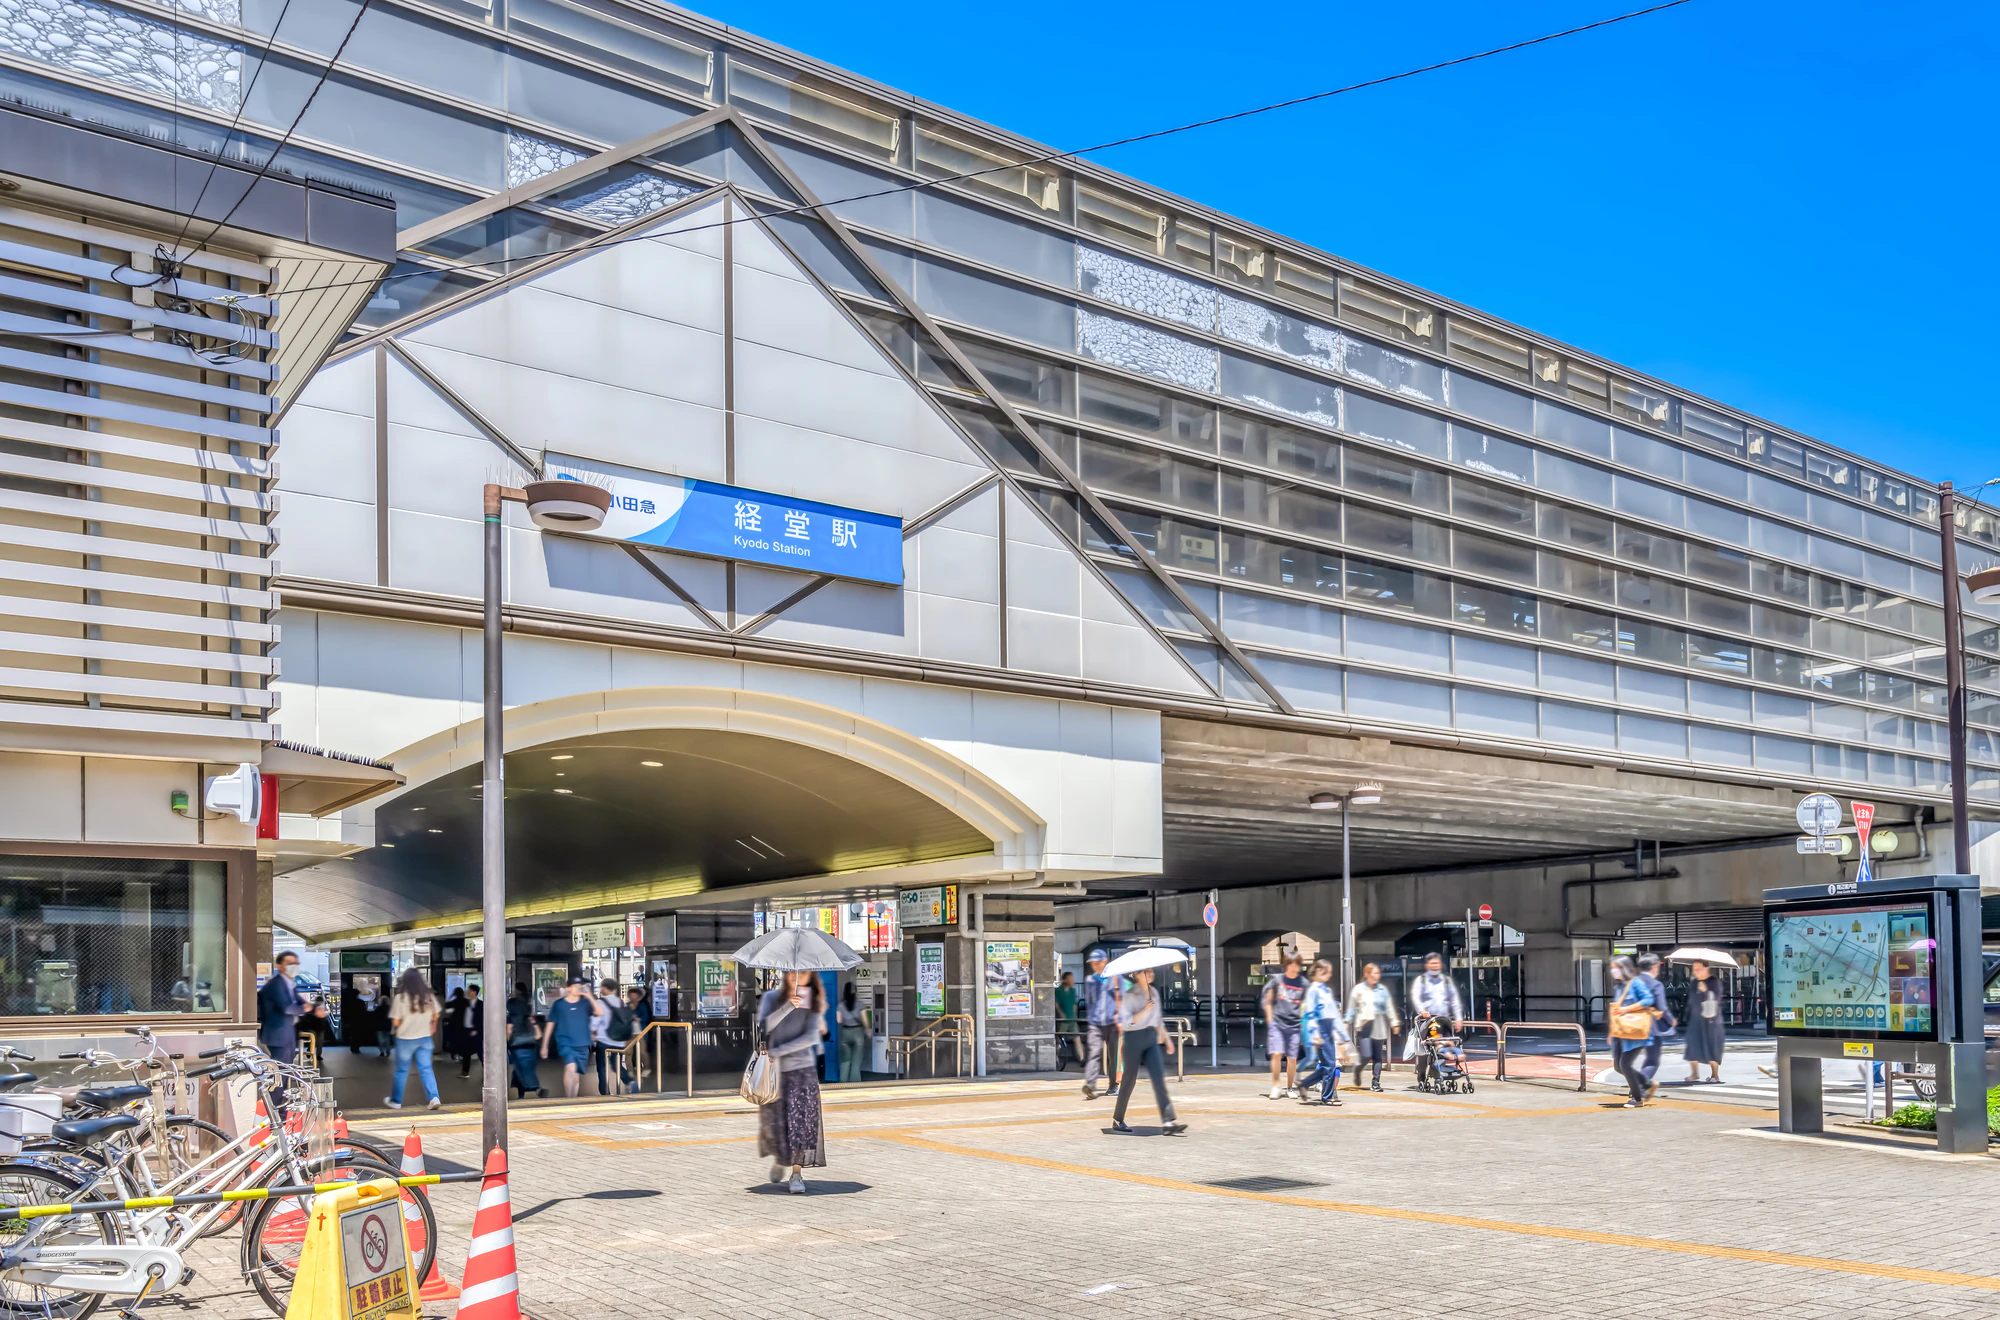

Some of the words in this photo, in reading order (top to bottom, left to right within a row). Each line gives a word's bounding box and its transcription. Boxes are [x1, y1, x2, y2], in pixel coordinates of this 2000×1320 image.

[609, 494, 656, 515] 小田急
[734, 501, 857, 549] 経堂駅
[734, 535, 769, 550] Kyodo
[772, 541, 811, 556] Station
[1856, 808, 1870, 819] 止まれ
[1858, 820, 1868, 829] STOP
[704, 974, 730, 985] LINE
[856, 968, 871, 977] PUDO
[355, 1273, 403, 1310] 駐輪禁止
